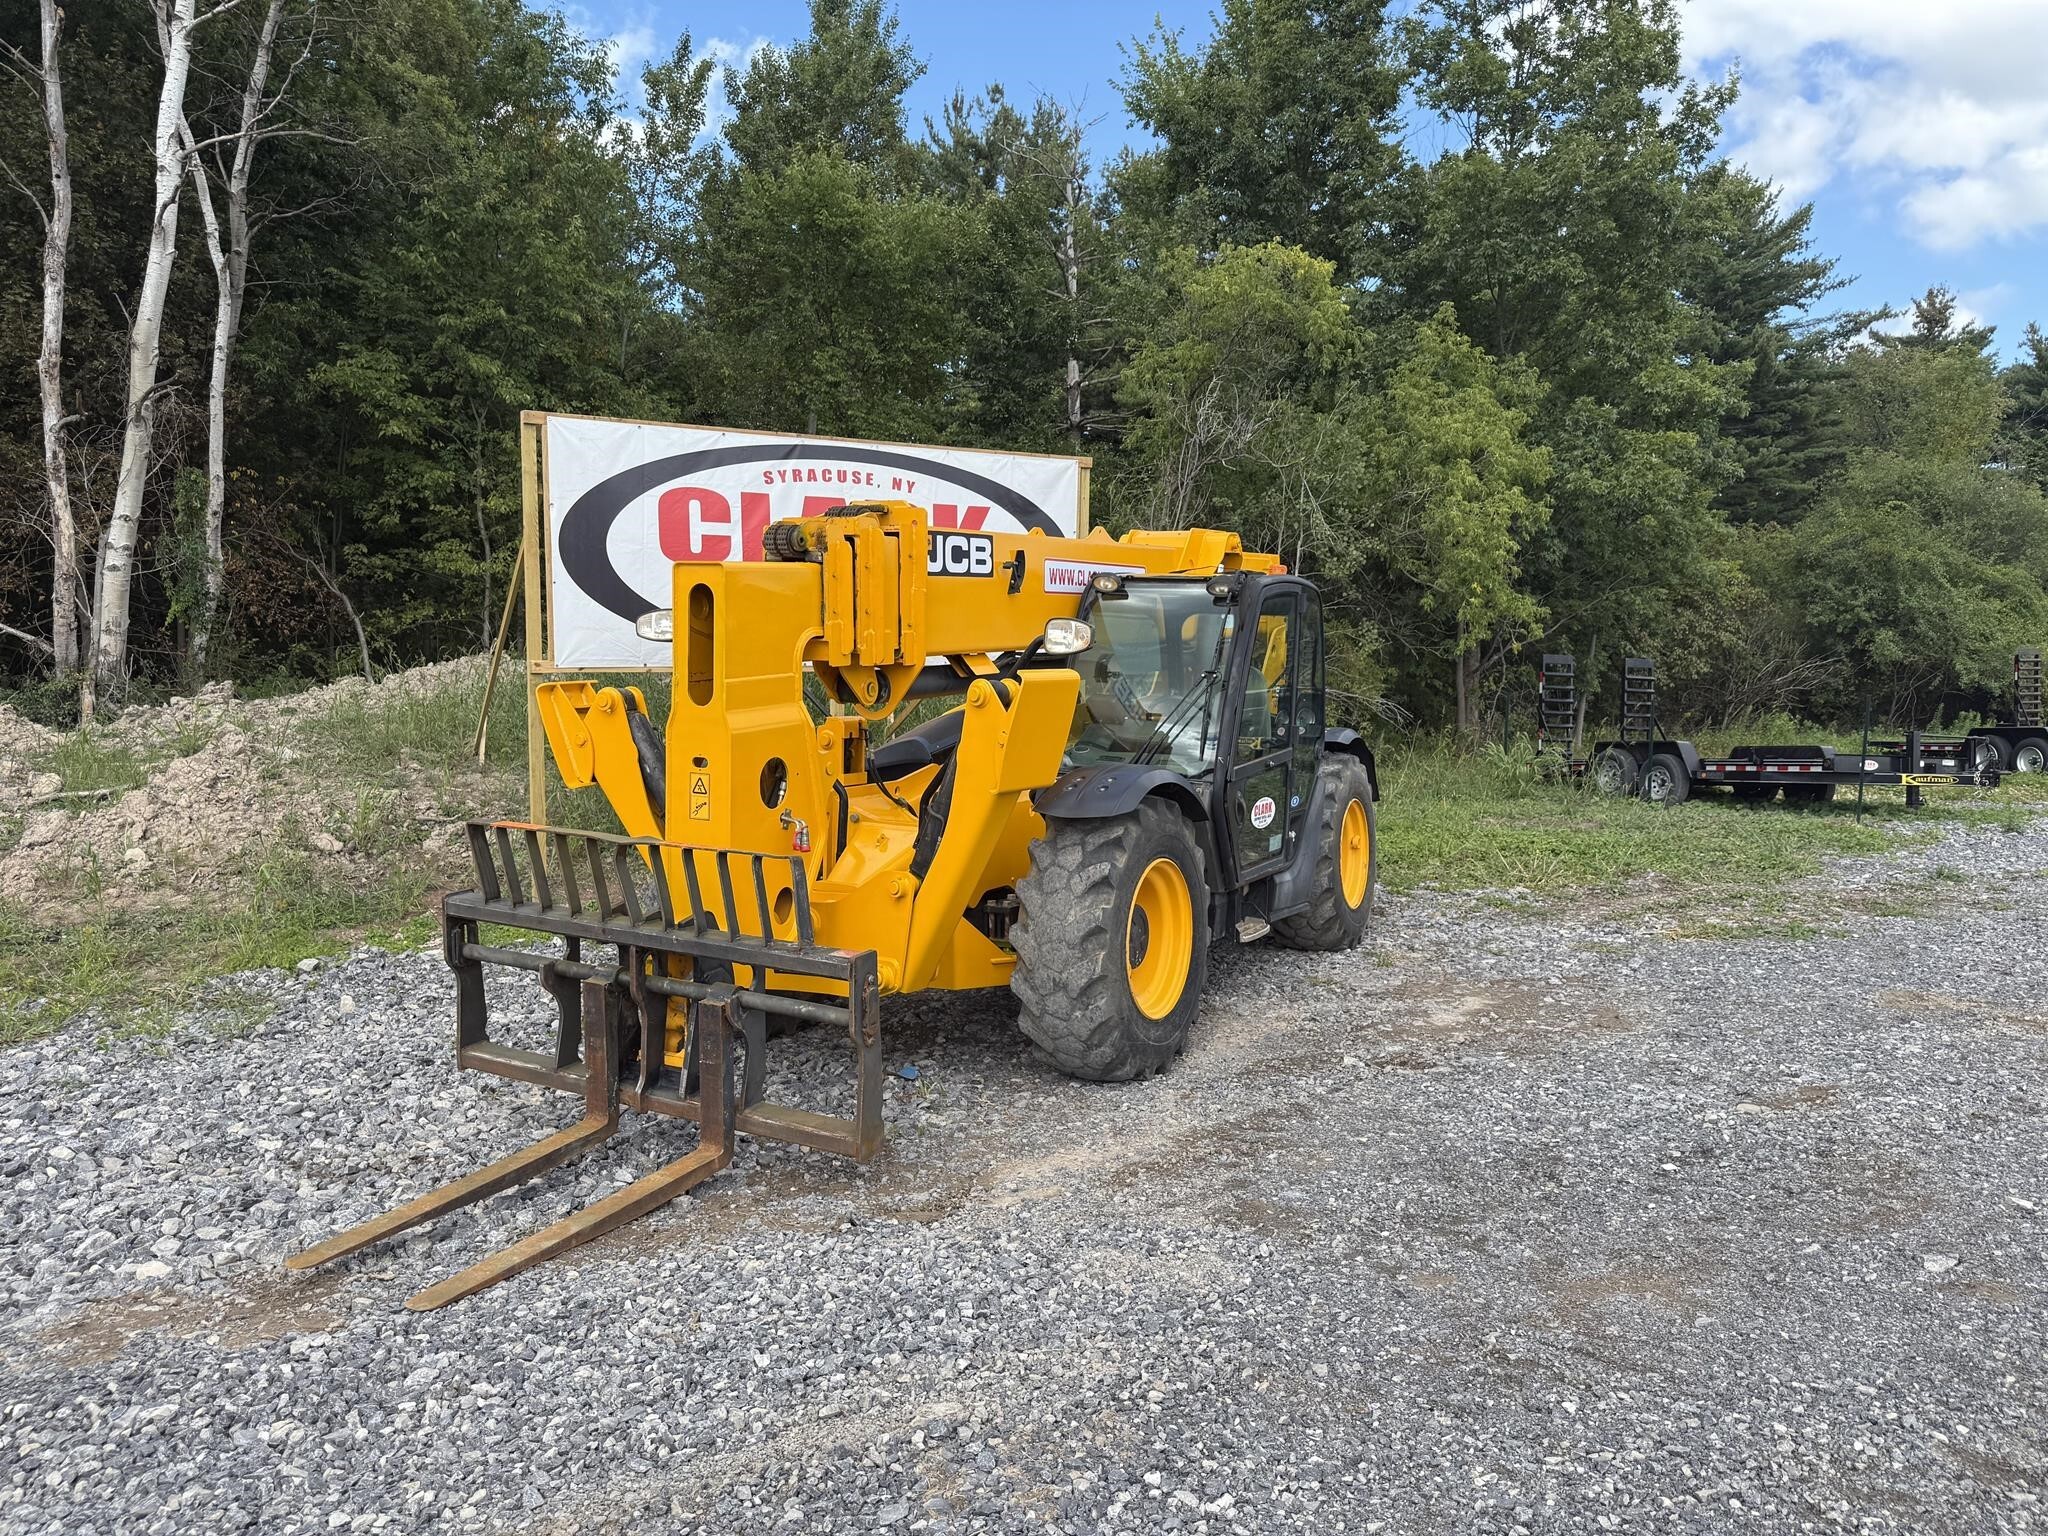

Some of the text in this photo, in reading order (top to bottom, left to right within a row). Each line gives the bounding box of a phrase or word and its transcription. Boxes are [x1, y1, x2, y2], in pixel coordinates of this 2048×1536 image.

[763, 468, 915, 493] SYRACUSE, NY
[658, 487, 991, 562] CLK
[928, 535, 993, 574] JCB
[1902, 773, 1954, 785] Kaufman
[1254, 801, 1273, 817] CLARK
